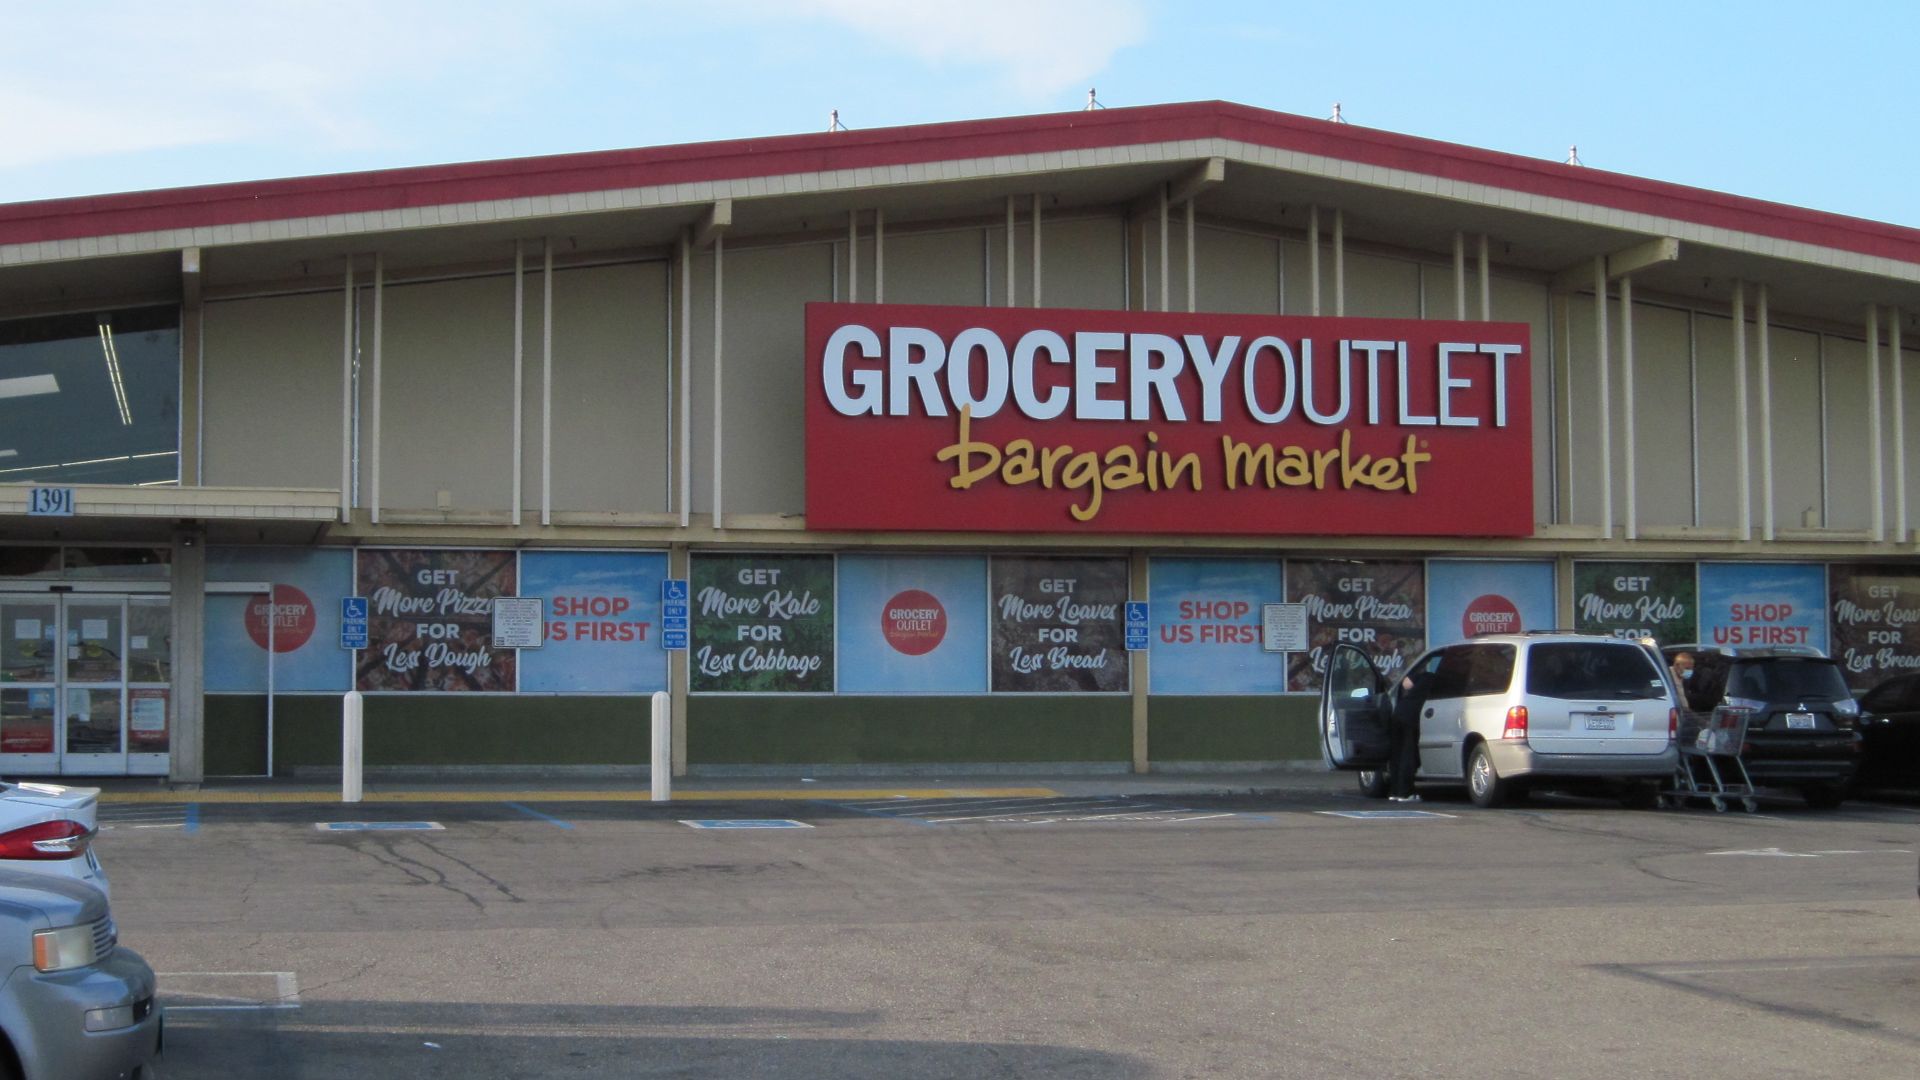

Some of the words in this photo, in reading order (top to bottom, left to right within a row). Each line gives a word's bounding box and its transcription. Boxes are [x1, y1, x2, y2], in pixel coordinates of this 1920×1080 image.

[937, 403, 1202, 521] bargain
[1222, 429, 1431, 494] market
[31, 489, 72, 513] 1391
[417, 569, 460, 585] GET
[738, 568, 781, 585] GET
[1039, 578, 1077, 593] GET
[1338, 578, 1374, 592] GET
[1613, 576, 1650, 591] GET
[373, 586, 435, 617] More
[1868, 586, 1900, 598] GET
[552, 596, 630, 616] SHOP
[697, 586, 761, 619] More
[763, 589, 820, 620] Kale
[998, 594, 1055, 622] More
[1056, 595, 1117, 625] Loaves
[1179, 600, 1249, 620] SHOP
[1301, 594, 1354, 623] More
[1355, 595, 1413, 620] Pizza
[1579, 593, 1634, 623] More
[1635, 595, 1685, 624] Kale
[1730, 603, 1793, 622] SHOP
[1834, 599, 1882, 626] More
[889, 608, 939, 620] GROCERY
[1469, 612, 1514, 623] GROCERY
[416, 623, 460, 639] FOR
[575, 621, 650, 641] FIRST
[737, 625, 782, 641] FOR
[896, 620, 931, 631] OUTLET
[1160, 624, 1194, 644] US
[1200, 624, 1265, 643] FIRST
[1338, 627, 1376, 642] FOR
[1475, 622, 1508, 633] OUTLET
[1713, 626, 1743, 644] US
[1749, 626, 1809, 644] FIRST
[1038, 628, 1078, 643] FOR
[1868, 631, 1901, 645] FOR
[384, 643, 422, 672] Less
[425, 643, 492, 675] Dough
[697, 645, 736, 676] Less
[738, 646, 822, 678] Cabbage
[1009, 646, 1044, 673] Less
[1047, 646, 1108, 669] Bread
[1844, 647, 1873, 673] Less
